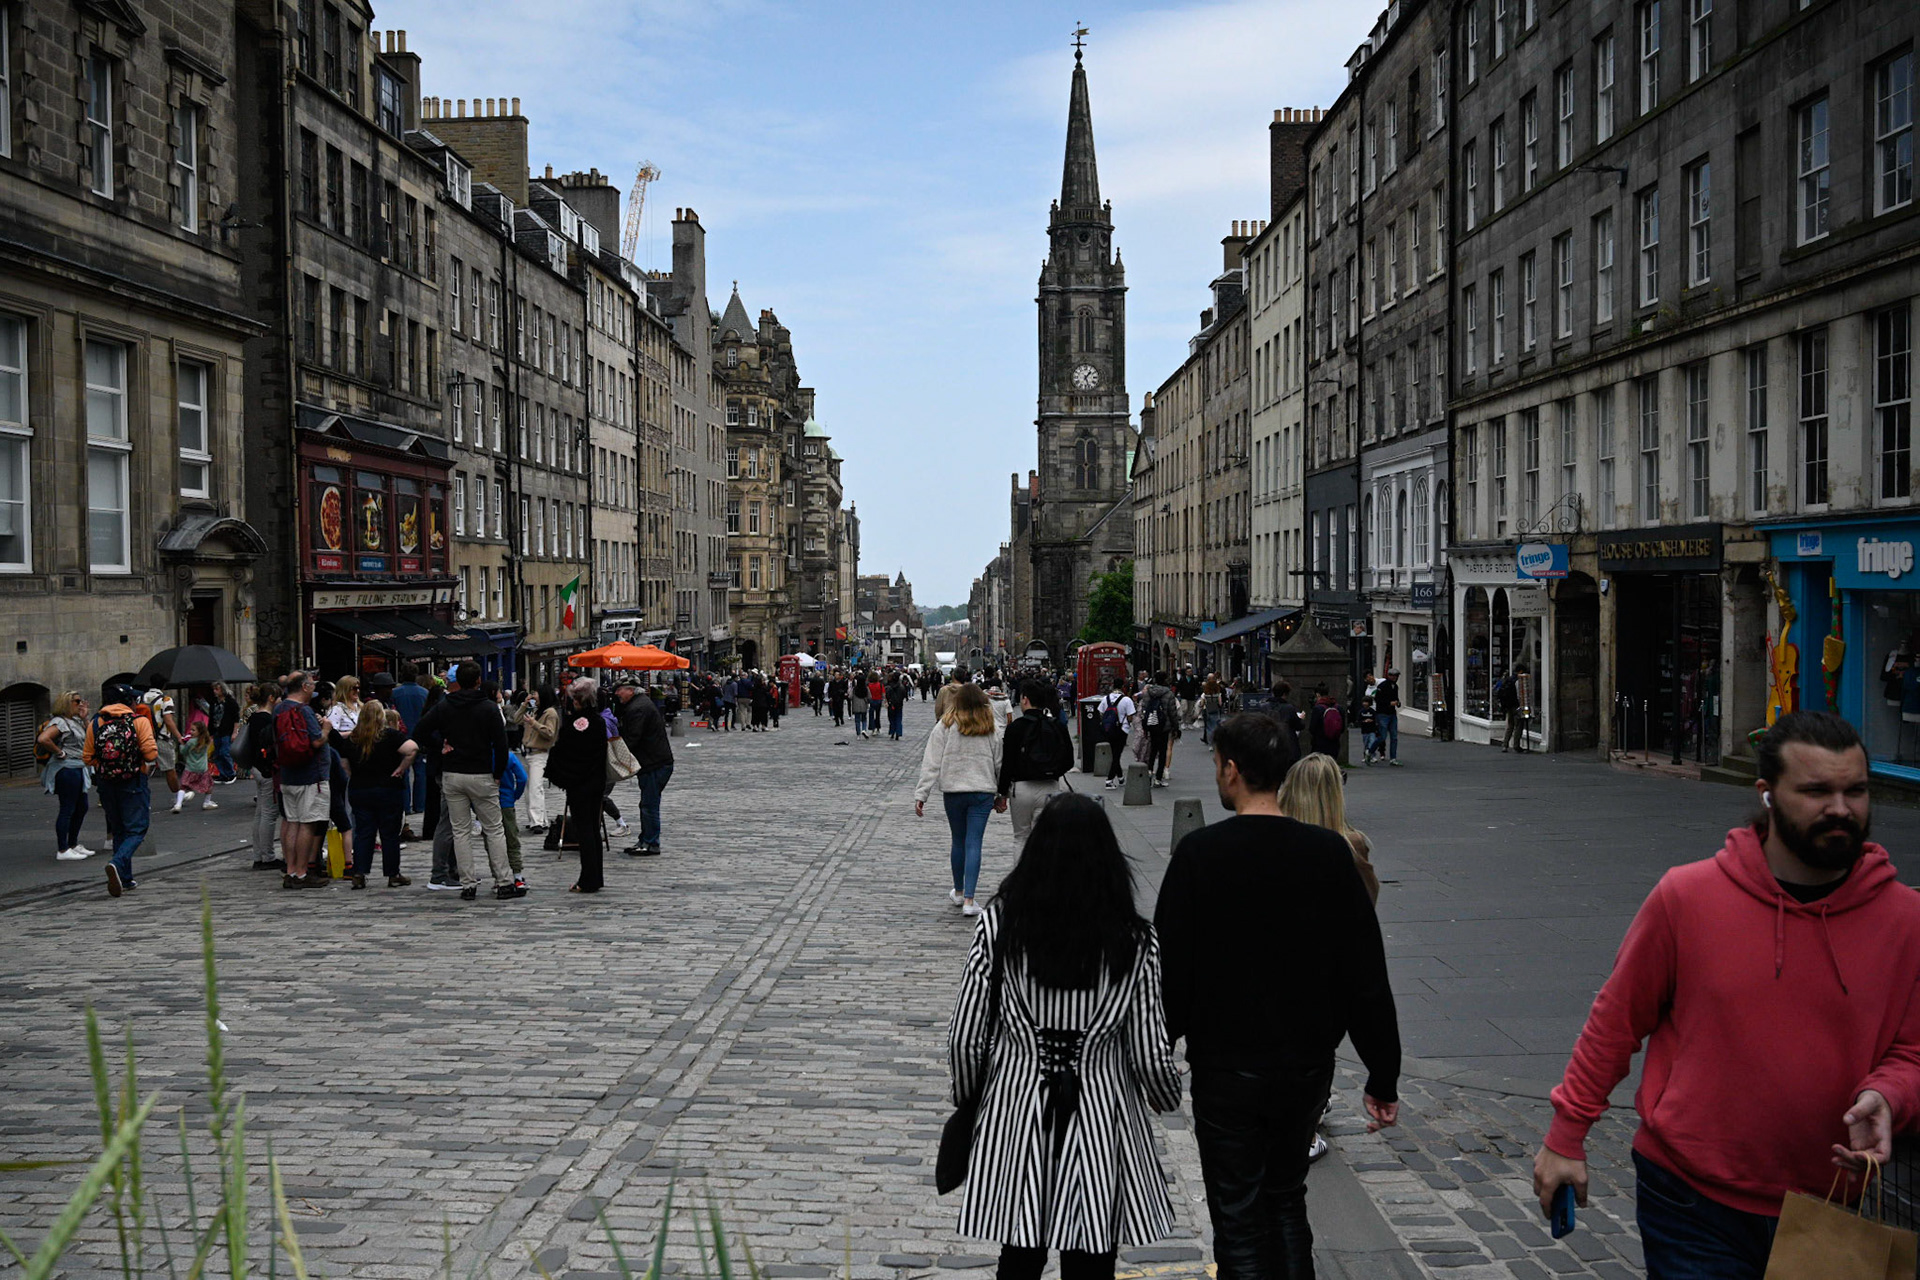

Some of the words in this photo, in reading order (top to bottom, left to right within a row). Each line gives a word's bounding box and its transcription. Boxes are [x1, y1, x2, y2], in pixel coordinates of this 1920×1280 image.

[1600, 542, 1633, 560] HOUSE
[1634, 541, 1650, 559] OF
[1651, 538, 1712, 558] CASHMERE
[1800, 534, 1820, 549] fringe
[1520, 551, 1551, 566] fringe
[1857, 537, 1914, 579] fringe
[1466, 563, 1484, 573] TASTE
[1485, 563, 1493, 573] OF
[334, 594, 350, 605] THE
[356, 593, 387, 604] FILLING
[1415, 587, 1433, 597] 166
